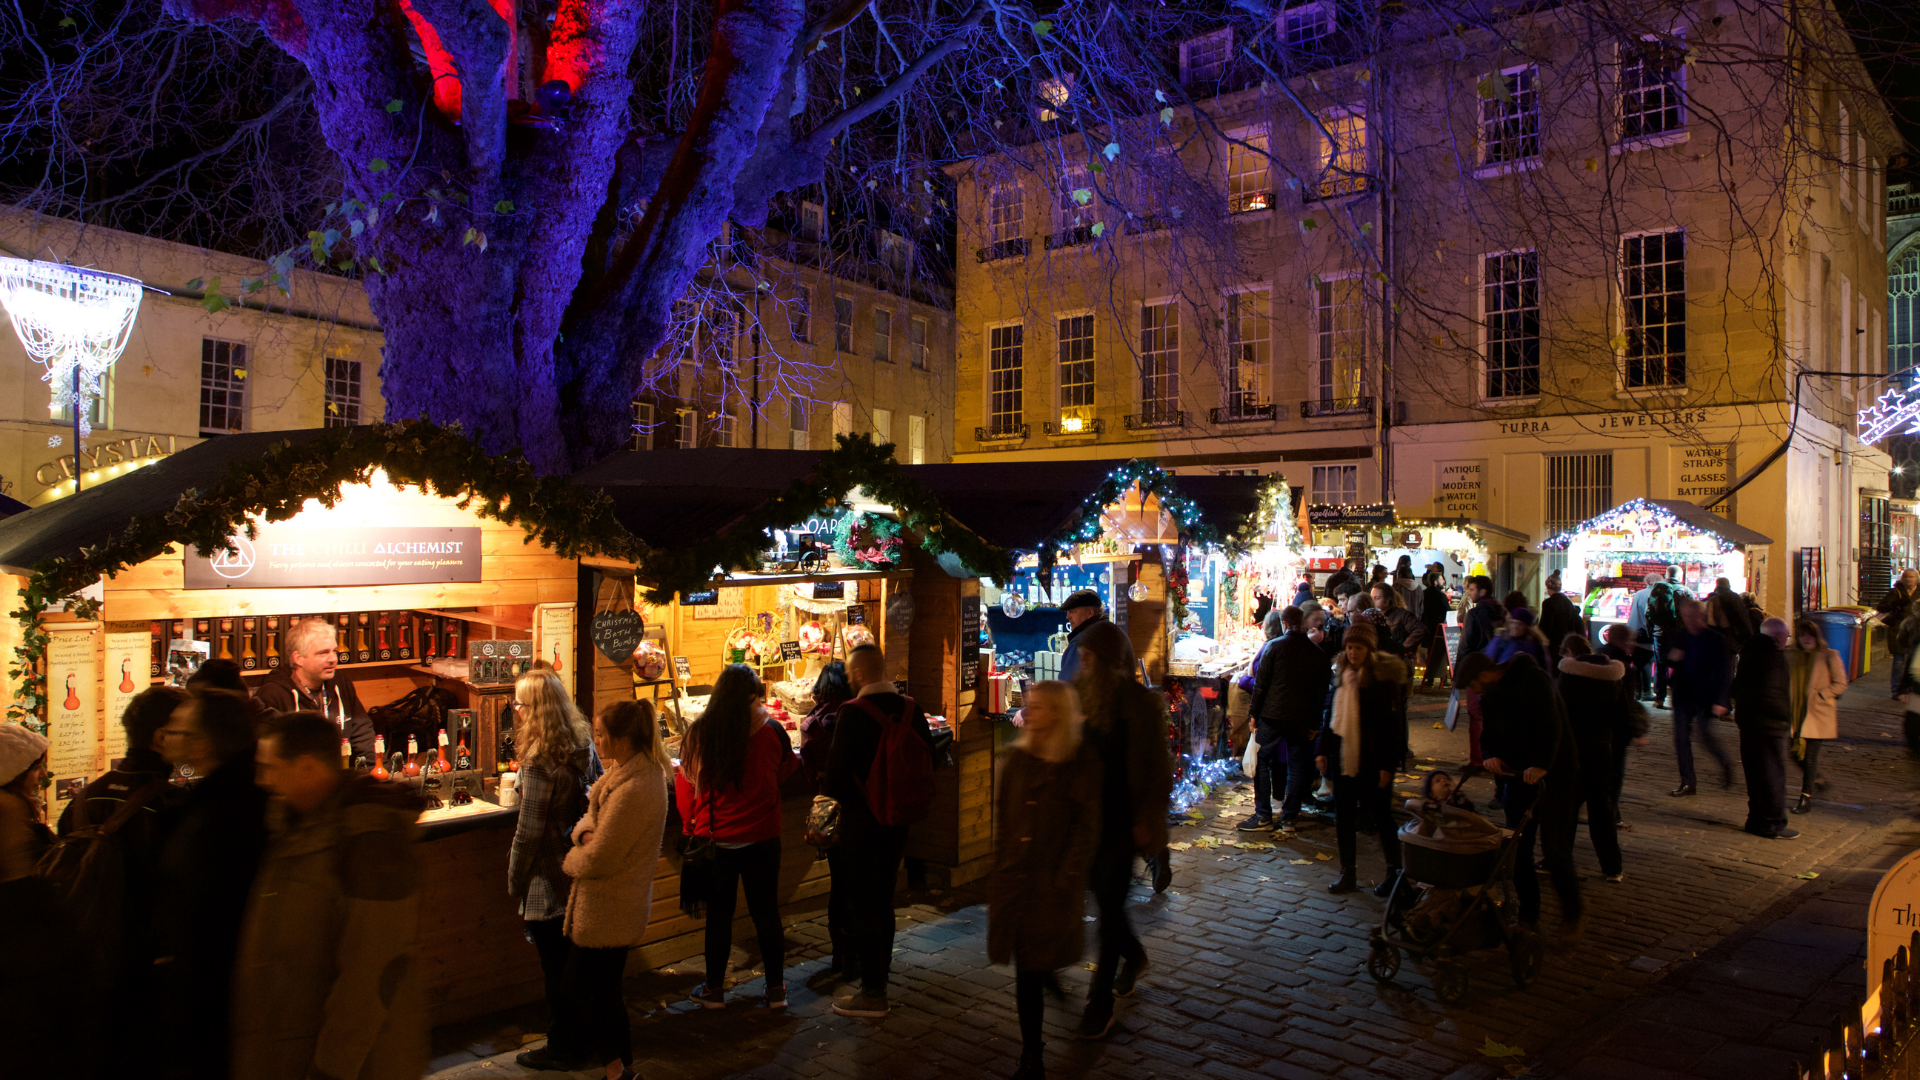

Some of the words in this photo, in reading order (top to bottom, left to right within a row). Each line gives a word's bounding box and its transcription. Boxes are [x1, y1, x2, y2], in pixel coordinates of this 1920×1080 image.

[1500, 421, 1550, 434] TUPRA
[1599, 412, 1706, 428] JEWELLERS
[1686, 449, 1721, 458] WATCH
[1683, 459, 1723, 468] STRAPS
[1443, 465, 1481, 474] ANTIQUE
[1680, 474, 1726, 482] GLASSES
[1442, 481, 1481, 490] MODERN
[1677, 486, 1732, 495] BATTERIES
[1341, 506, 1390, 517] Restaurant
[801, 518, 842, 534] SOAP
[269, 543, 305, 556] THE
[312, 542, 367, 555] CHILLI
[372, 542, 463, 555] ALCHEMIST
[317, 560, 332, 570] and
[355, 560, 386, 568] concocted
[385, 559, 396, 570] for
[398, 560, 413, 570] your
[414, 559, 435, 570] eating
[435, 559, 463, 569] pleasure
[595, 616, 638, 629] CHRISTMAS
[53, 635, 72, 644] Price
